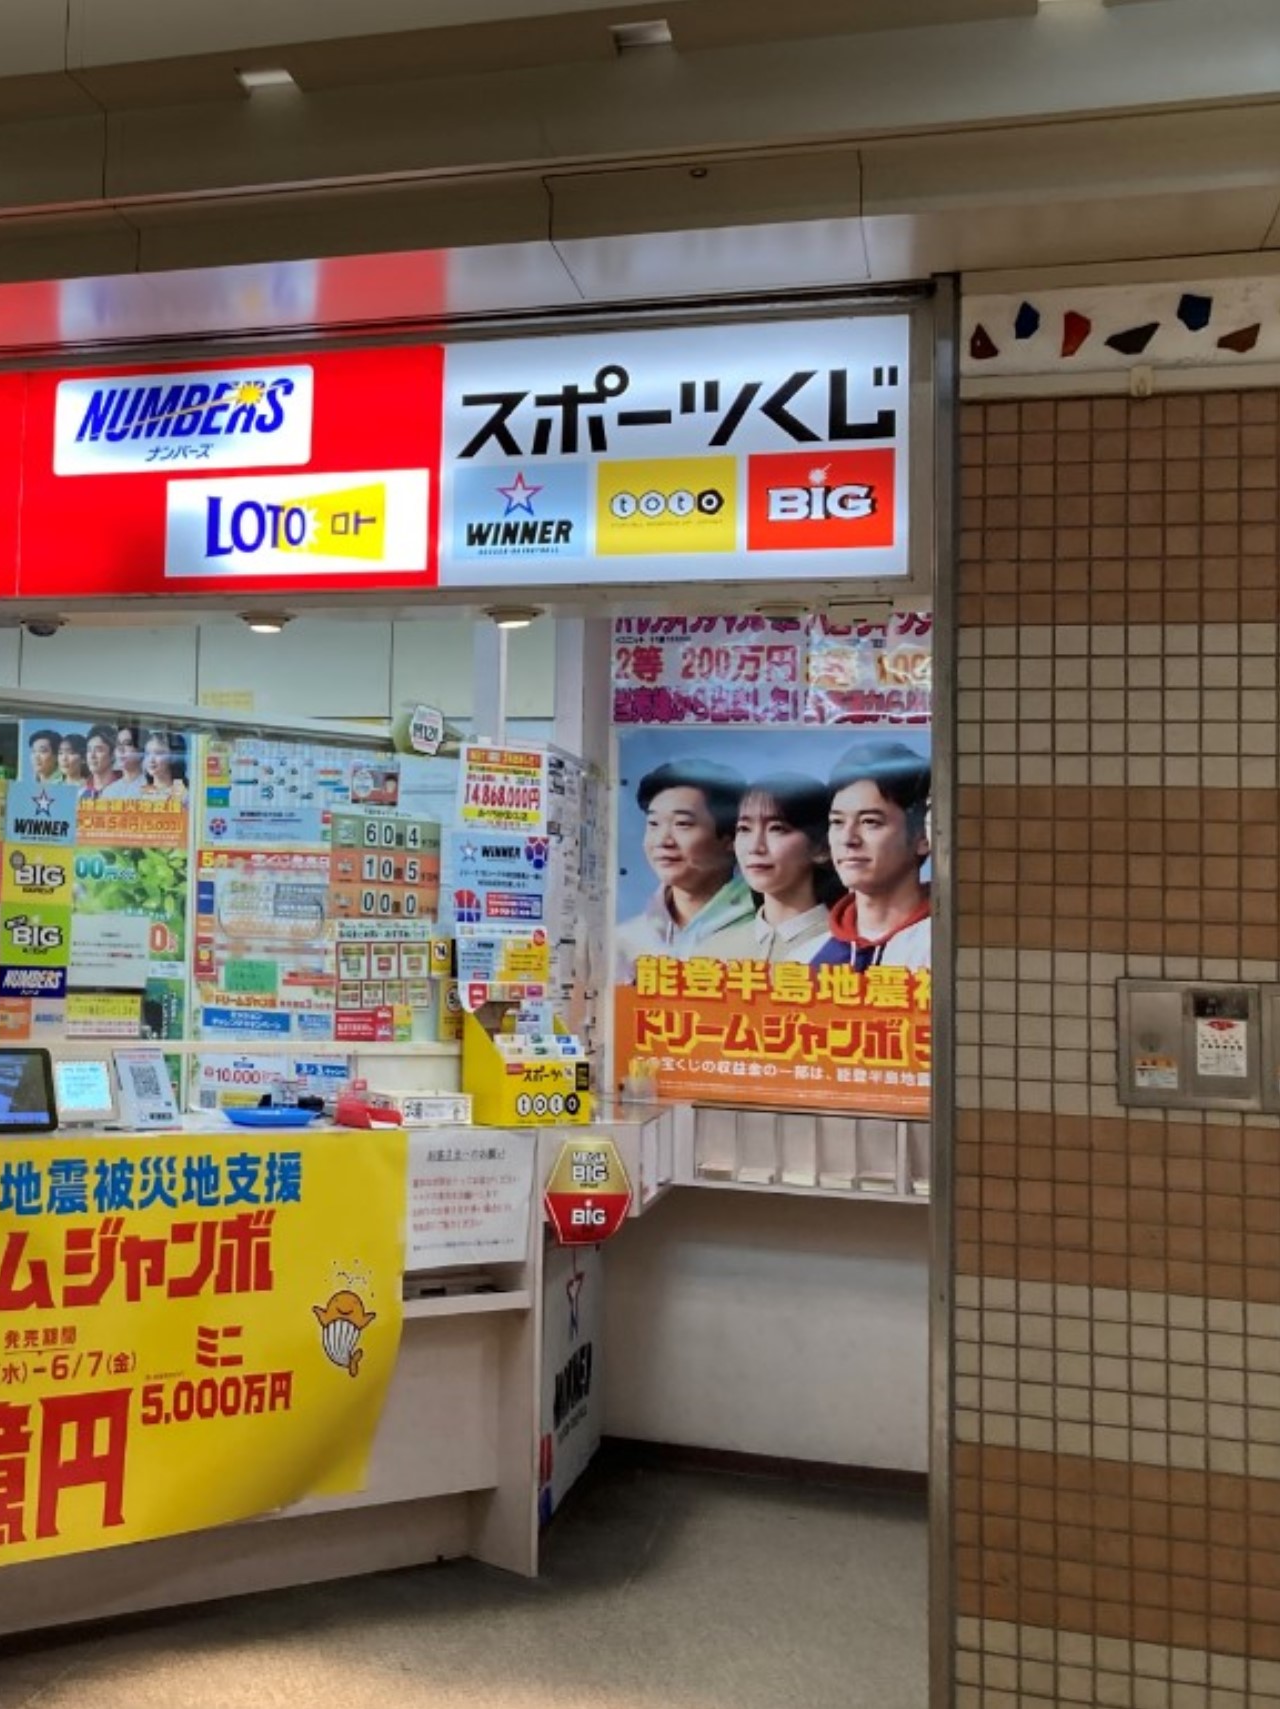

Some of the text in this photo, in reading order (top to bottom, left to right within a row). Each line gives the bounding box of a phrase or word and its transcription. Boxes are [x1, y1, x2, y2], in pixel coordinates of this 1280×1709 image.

[75, 378, 295, 443] NUMBERS
[456, 364, 899, 459] スポーツくじ
[145, 442, 215, 463] ナンバーズ
[610, 489, 724, 520] toto
[205, 495, 308, 558] LOTO
[331, 510, 378, 536] ロト
[465, 519, 574, 547] WINNER
[14, 818, 70, 837] WINNER
[634, 1009, 908, 1066] ドリームジャンボ
[572, 1164, 608, 1182] BIG
[571, 1201, 606, 1225] BIG
[4, 1327, 76, 1348] 発売期間
[196, 1326, 243, 1367] ミニ
